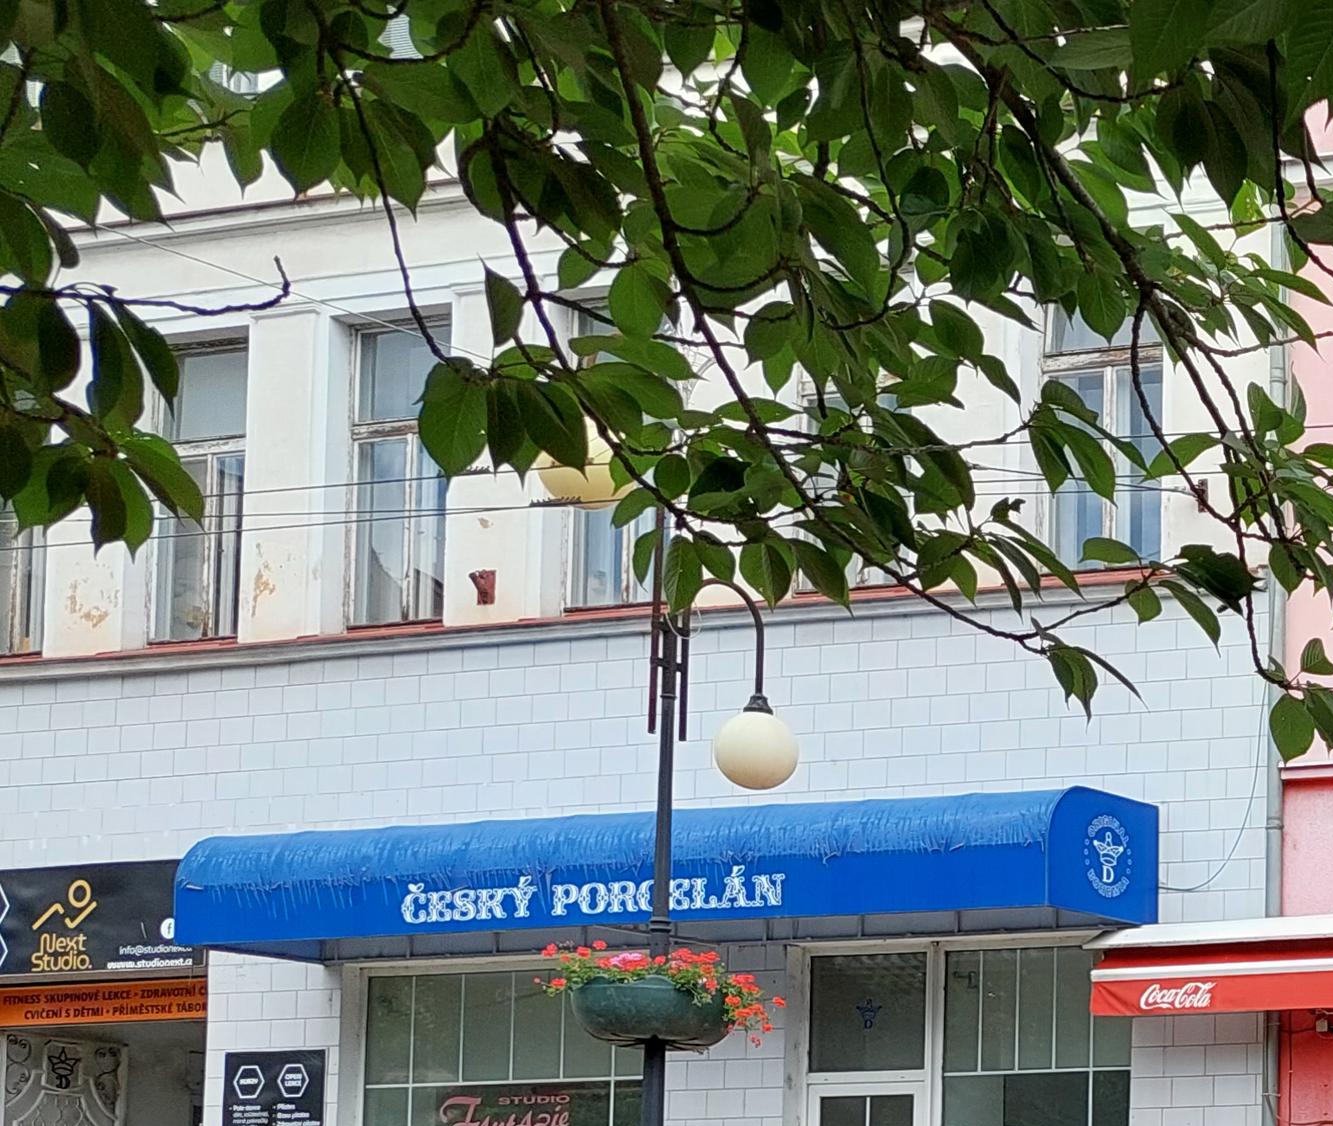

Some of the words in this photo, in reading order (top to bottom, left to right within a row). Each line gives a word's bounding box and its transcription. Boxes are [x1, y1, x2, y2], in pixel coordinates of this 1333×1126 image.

[401, 875, 538, 924] ČESKÝ
[551, 865, 786, 917] PORCELÁN
[41, 933, 87, 955] Next
[102, 988, 132, 1000] LEKCE
[75, 1005, 104, 1018] DĚTMI
[112, 1001, 173, 1017] PŘÍMĚSTSKÉ
[498, 1094, 570, 1105] STUDIO
